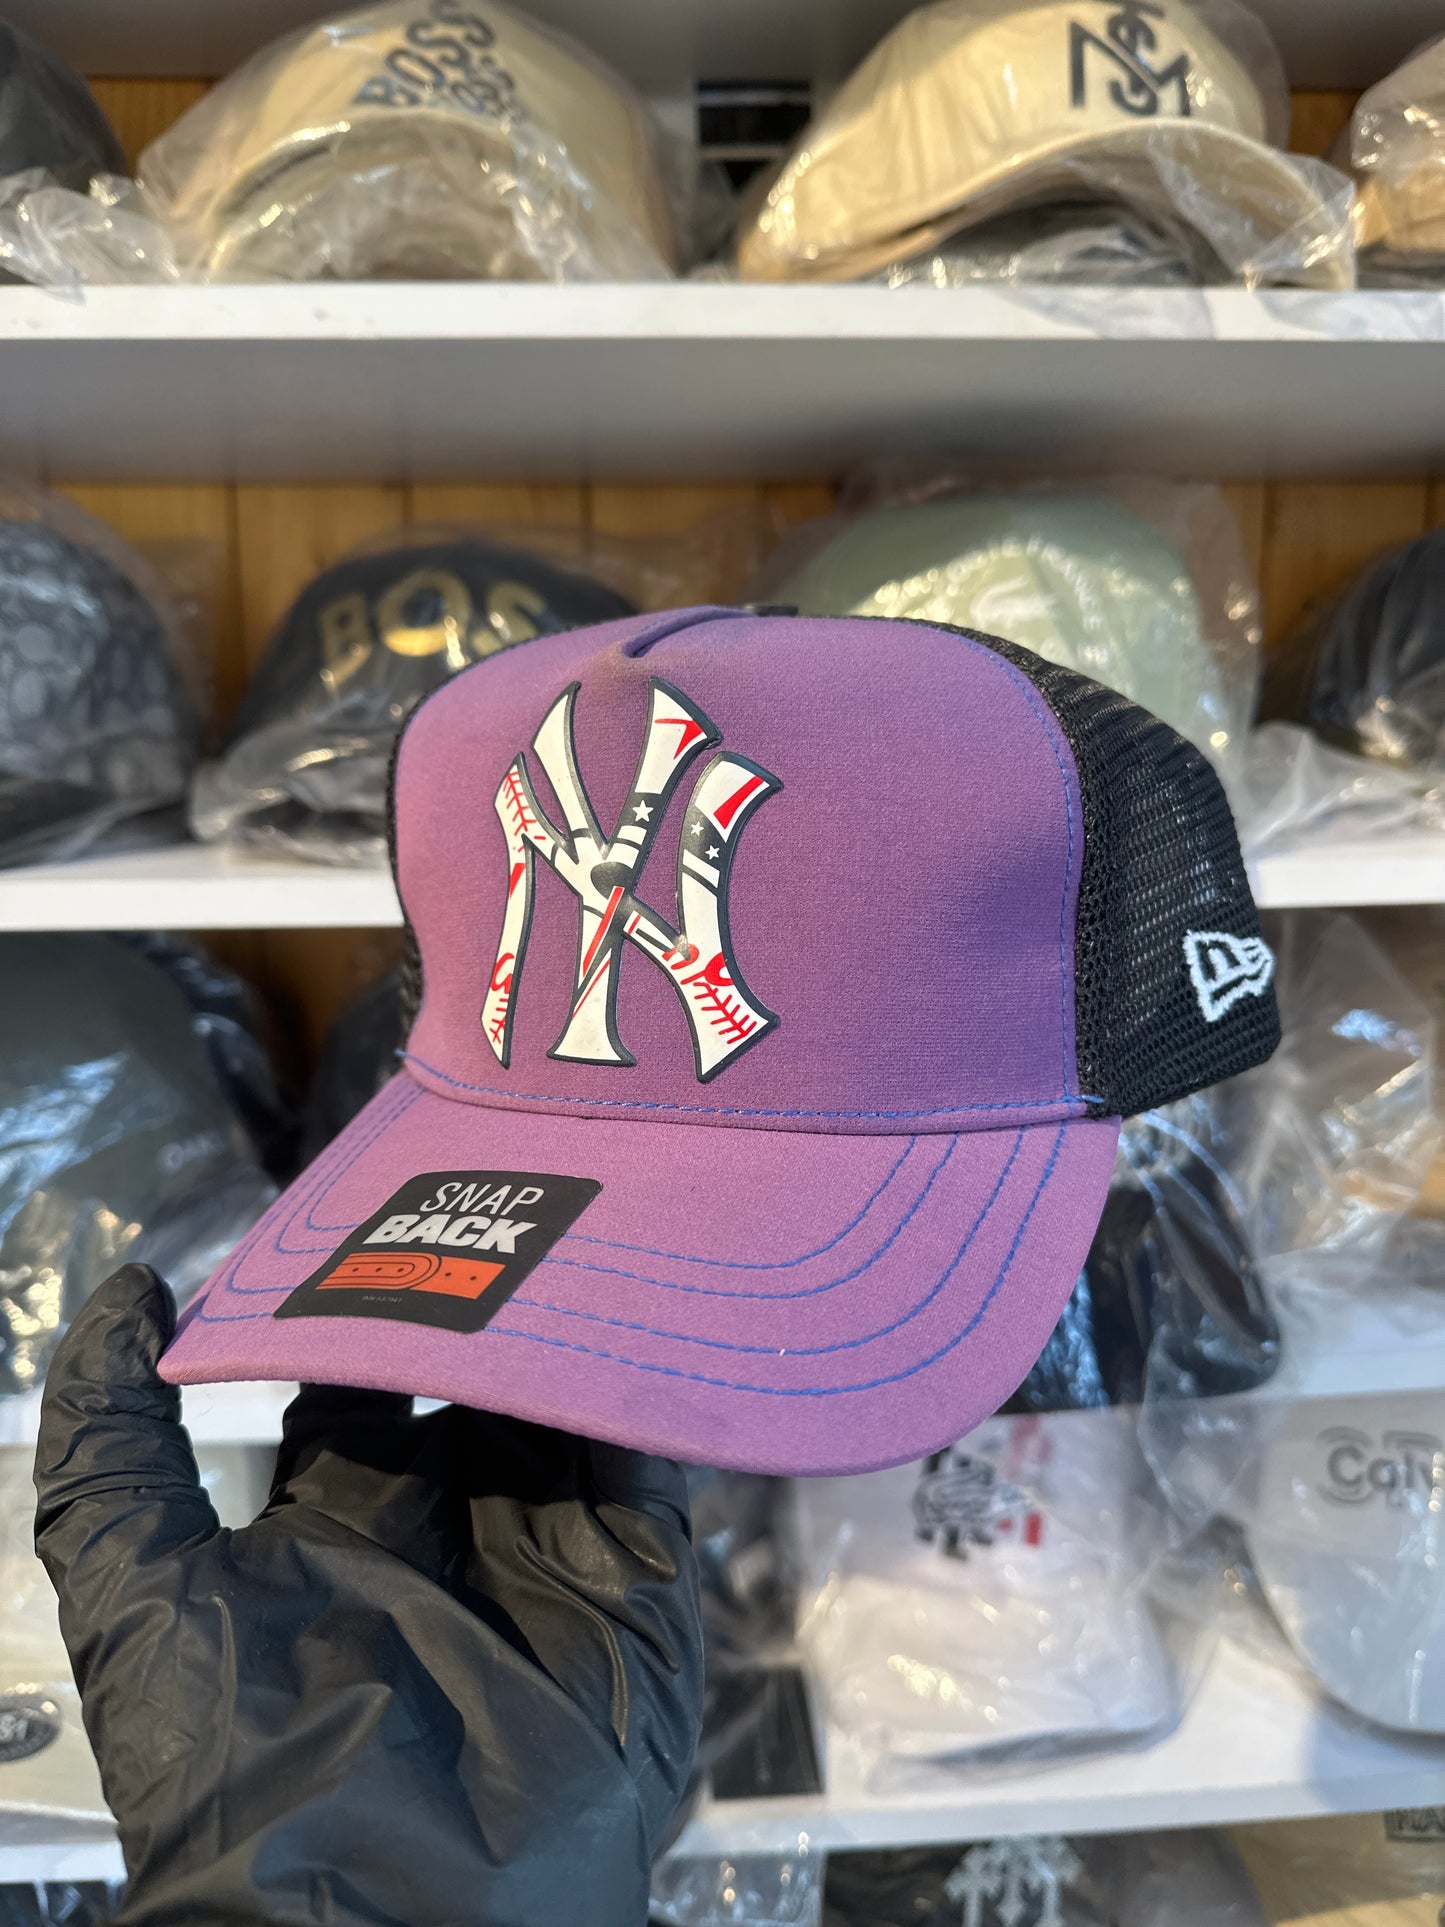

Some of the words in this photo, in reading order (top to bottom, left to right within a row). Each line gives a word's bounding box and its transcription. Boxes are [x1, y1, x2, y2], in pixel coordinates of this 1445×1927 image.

[480, 676, 784, 1084] NY
[419, 1181, 544, 1216] SNAP
[362, 1213, 538, 1254] BACK
